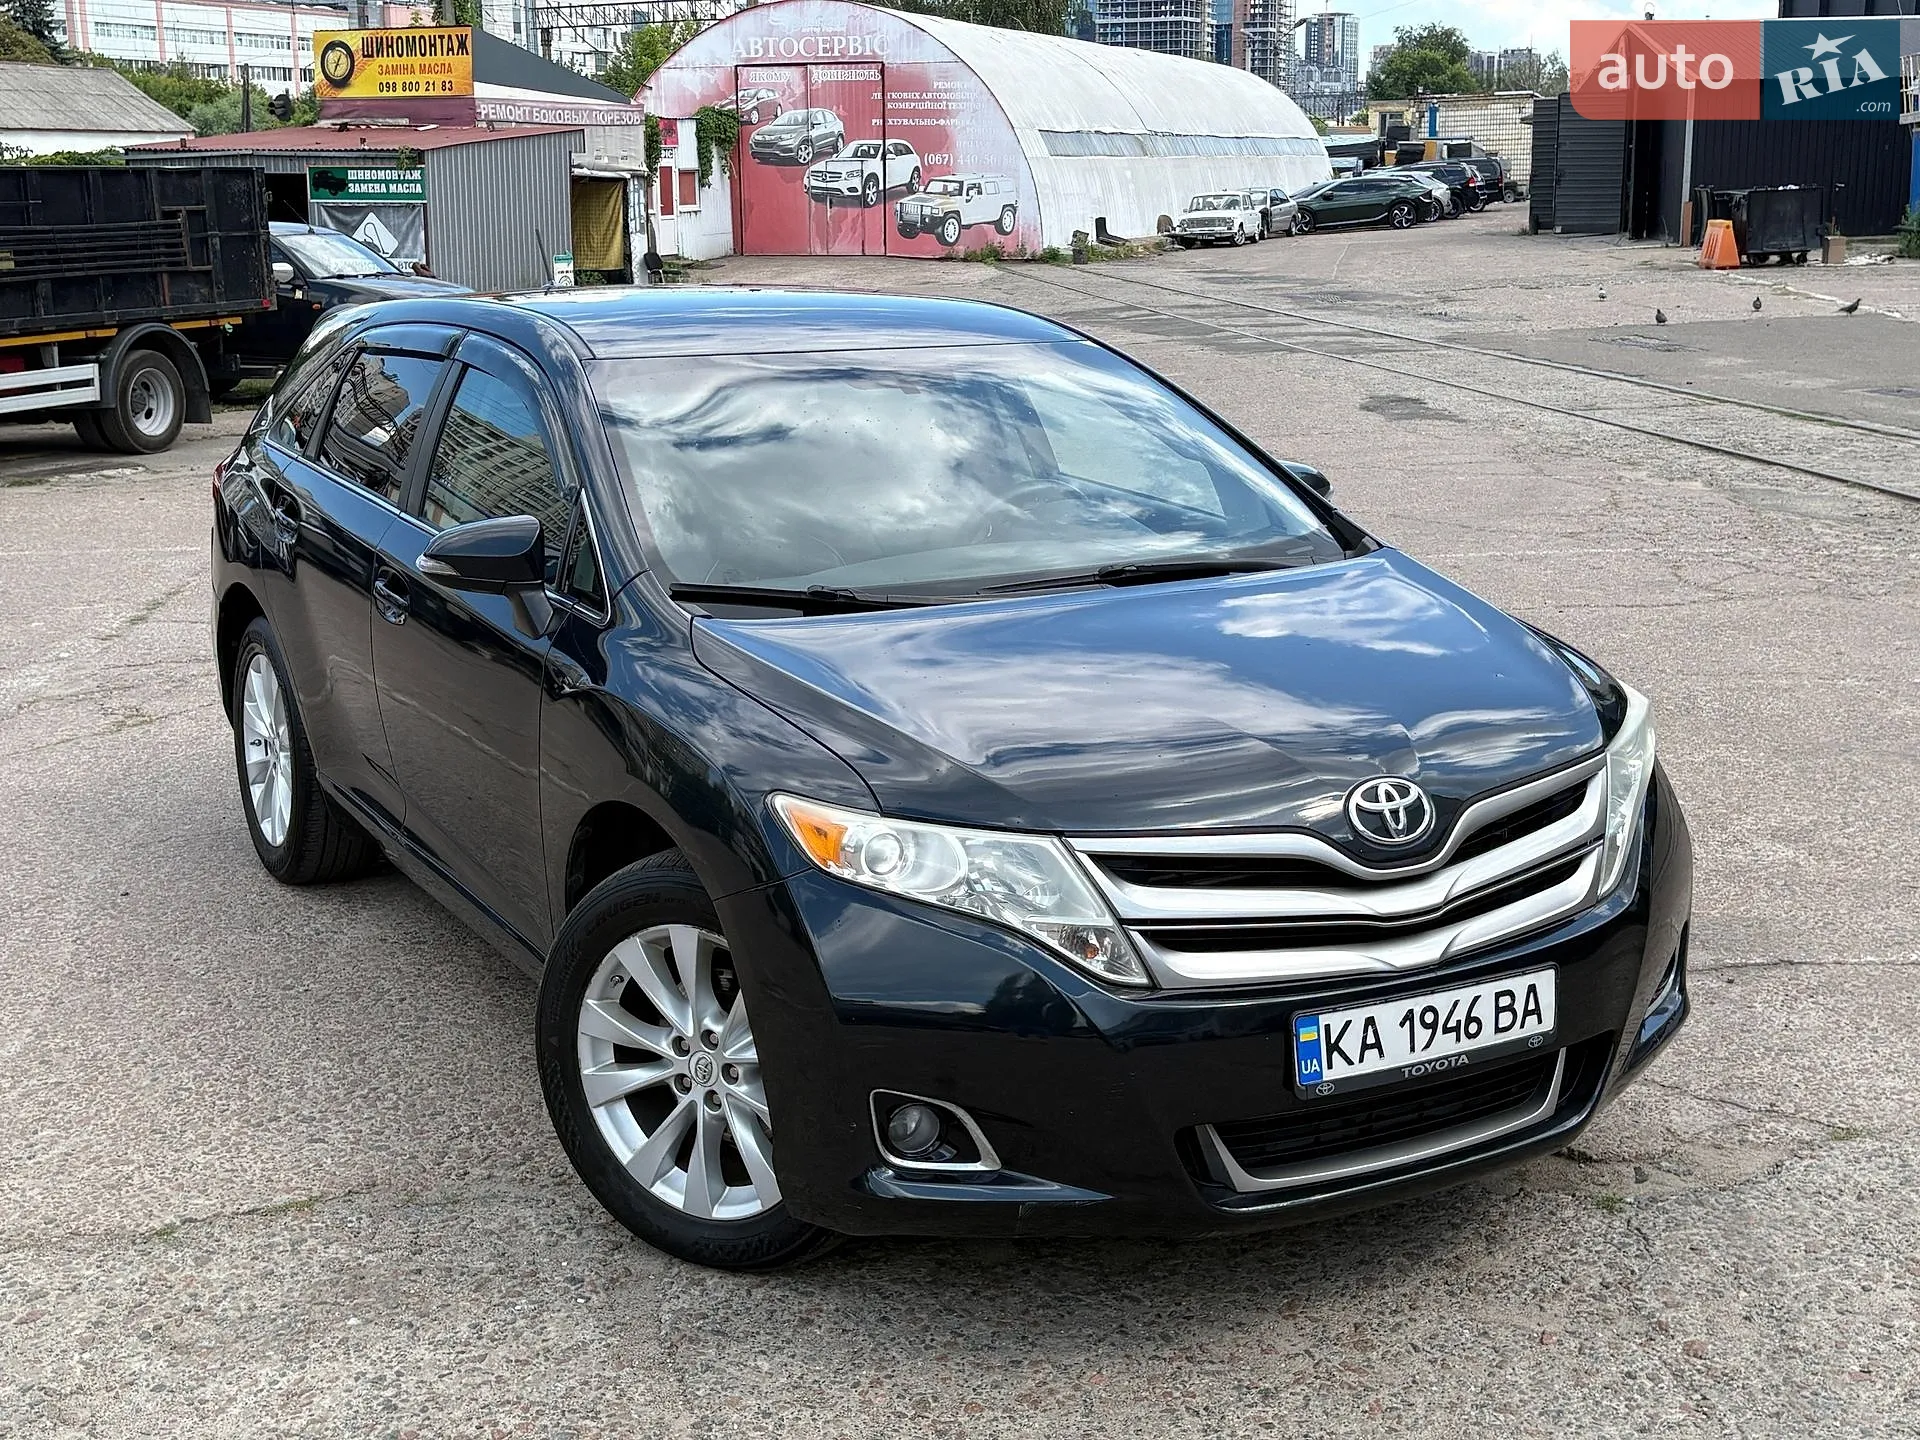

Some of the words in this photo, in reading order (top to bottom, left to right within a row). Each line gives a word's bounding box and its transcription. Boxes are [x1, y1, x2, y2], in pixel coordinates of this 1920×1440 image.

[361, 34, 469, 58] ШИНОМОНТАЖ
[732, 35, 890, 58] АВТОСЕРВІС
[378, 64, 415, 76] ЗАМІНА
[419, 62, 453, 75] МАСЛА
[750, 70, 790, 83] ЯКОМУ
[812, 69, 881, 83] ДОВІРЯЮТЬ
[378, 82, 397, 93] 098
[402, 81, 420, 92] 800
[425, 81, 436, 92] 21
[441, 80, 453, 91] 83
[533, 108, 589, 123] БОКОВЫХ
[924, 153, 953, 166] (067)
[347, 169, 422, 180] ШИНОМОНТАЖ
[348, 183, 387, 193] ЗАМЕНА
[389, 183, 422, 193] МАСЛА
[1324, 1015, 1386, 1070] KA
[1399, 994, 1483, 1055] 1946
[1493, 983, 1543, 1035] BA
[1301, 1059, 1321, 1075] UA
[1401, 1054, 1470, 1079] TOYOTA
